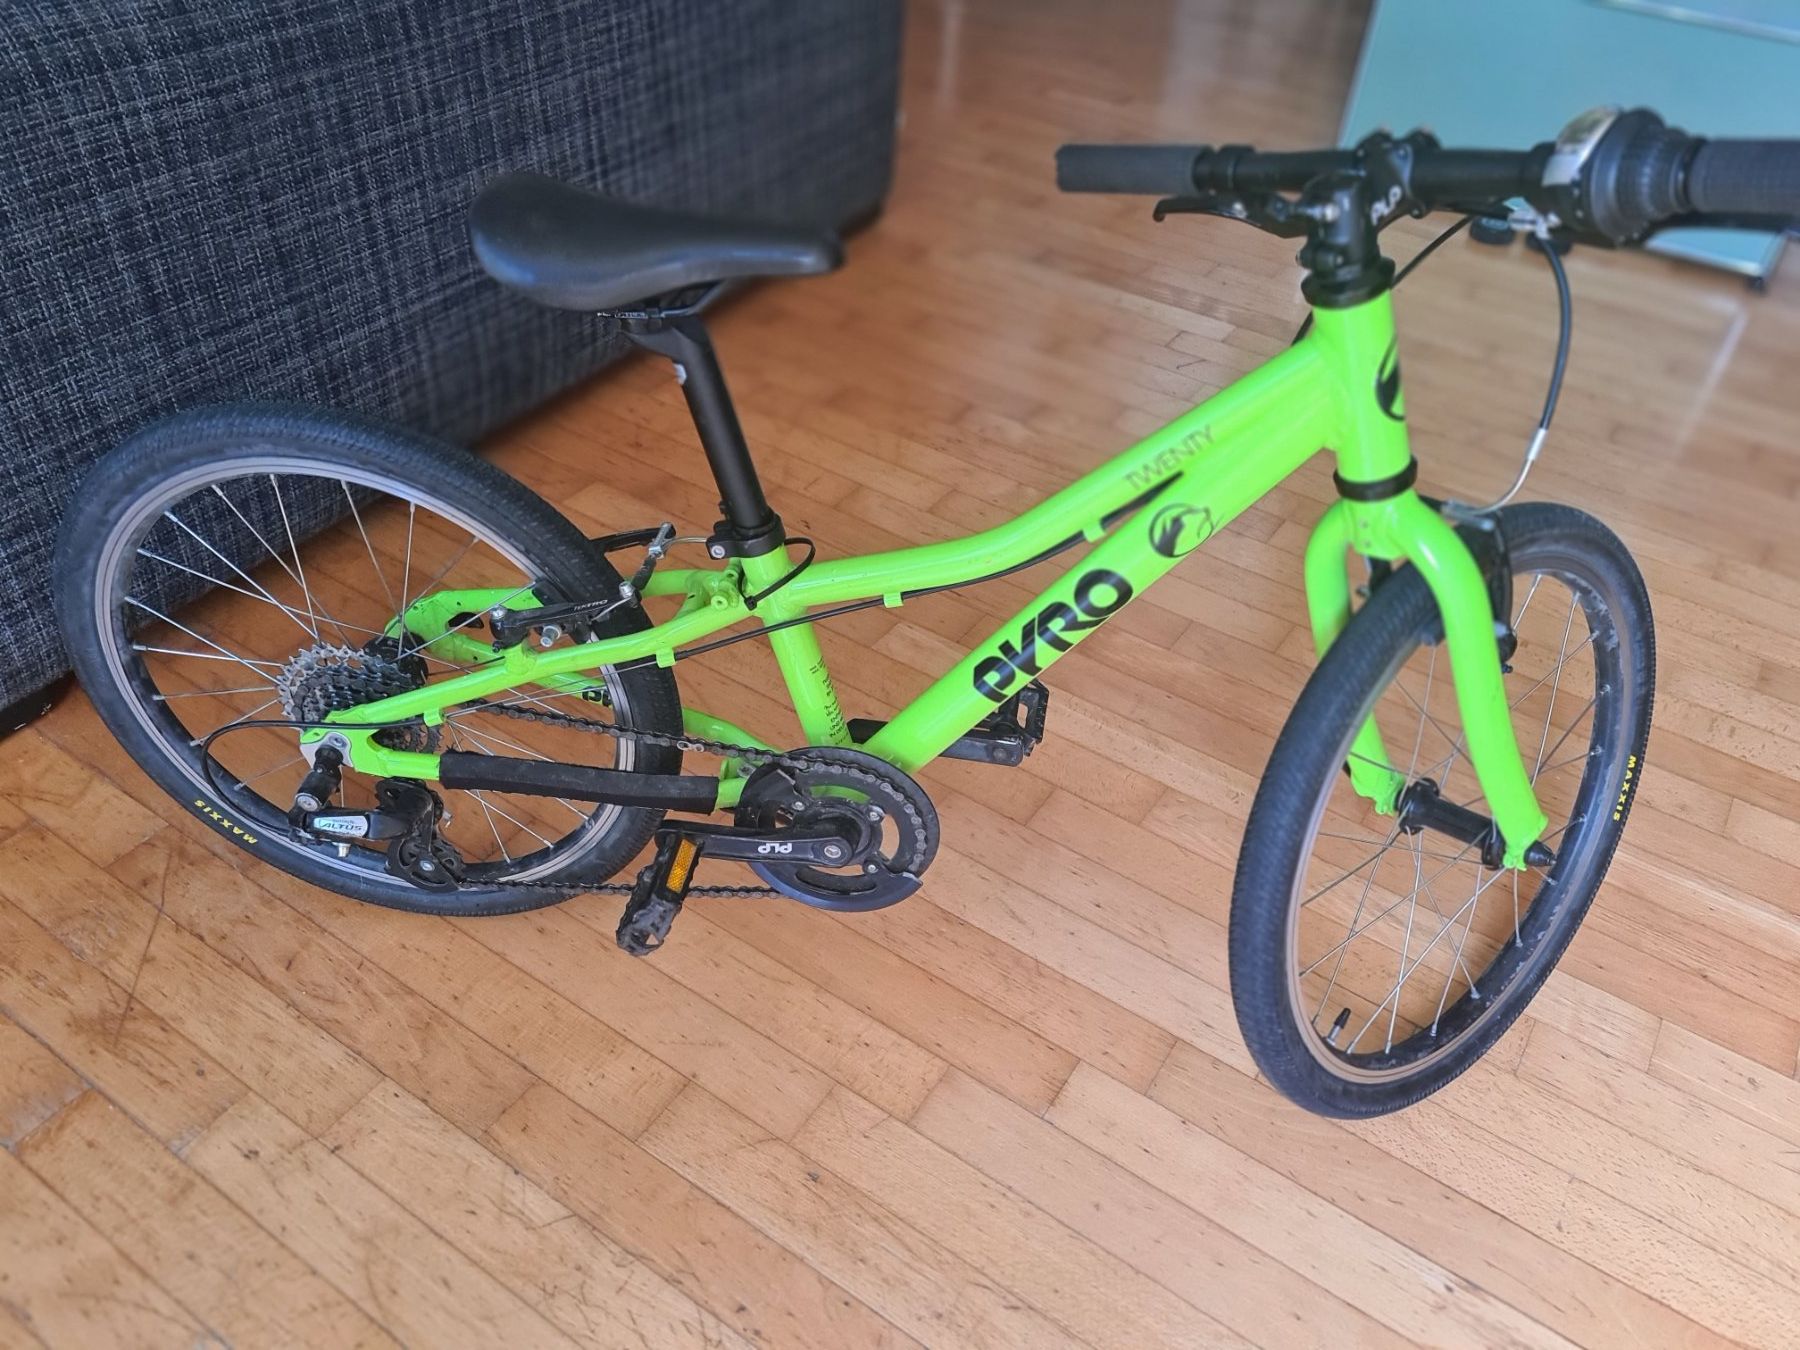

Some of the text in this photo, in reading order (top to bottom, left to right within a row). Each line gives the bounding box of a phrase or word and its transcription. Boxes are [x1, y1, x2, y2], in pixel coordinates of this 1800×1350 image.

[1370, 184, 1402, 226] PLP
[1125, 424, 1215, 491] TWENTY
[973, 568, 1133, 703] PYRO
[1613, 754, 1637, 821] MAXXIS
[194, 799, 259, 844] MAXXIS
[320, 821, 364, 832] ALTUS
[757, 842, 793, 854] PLP
